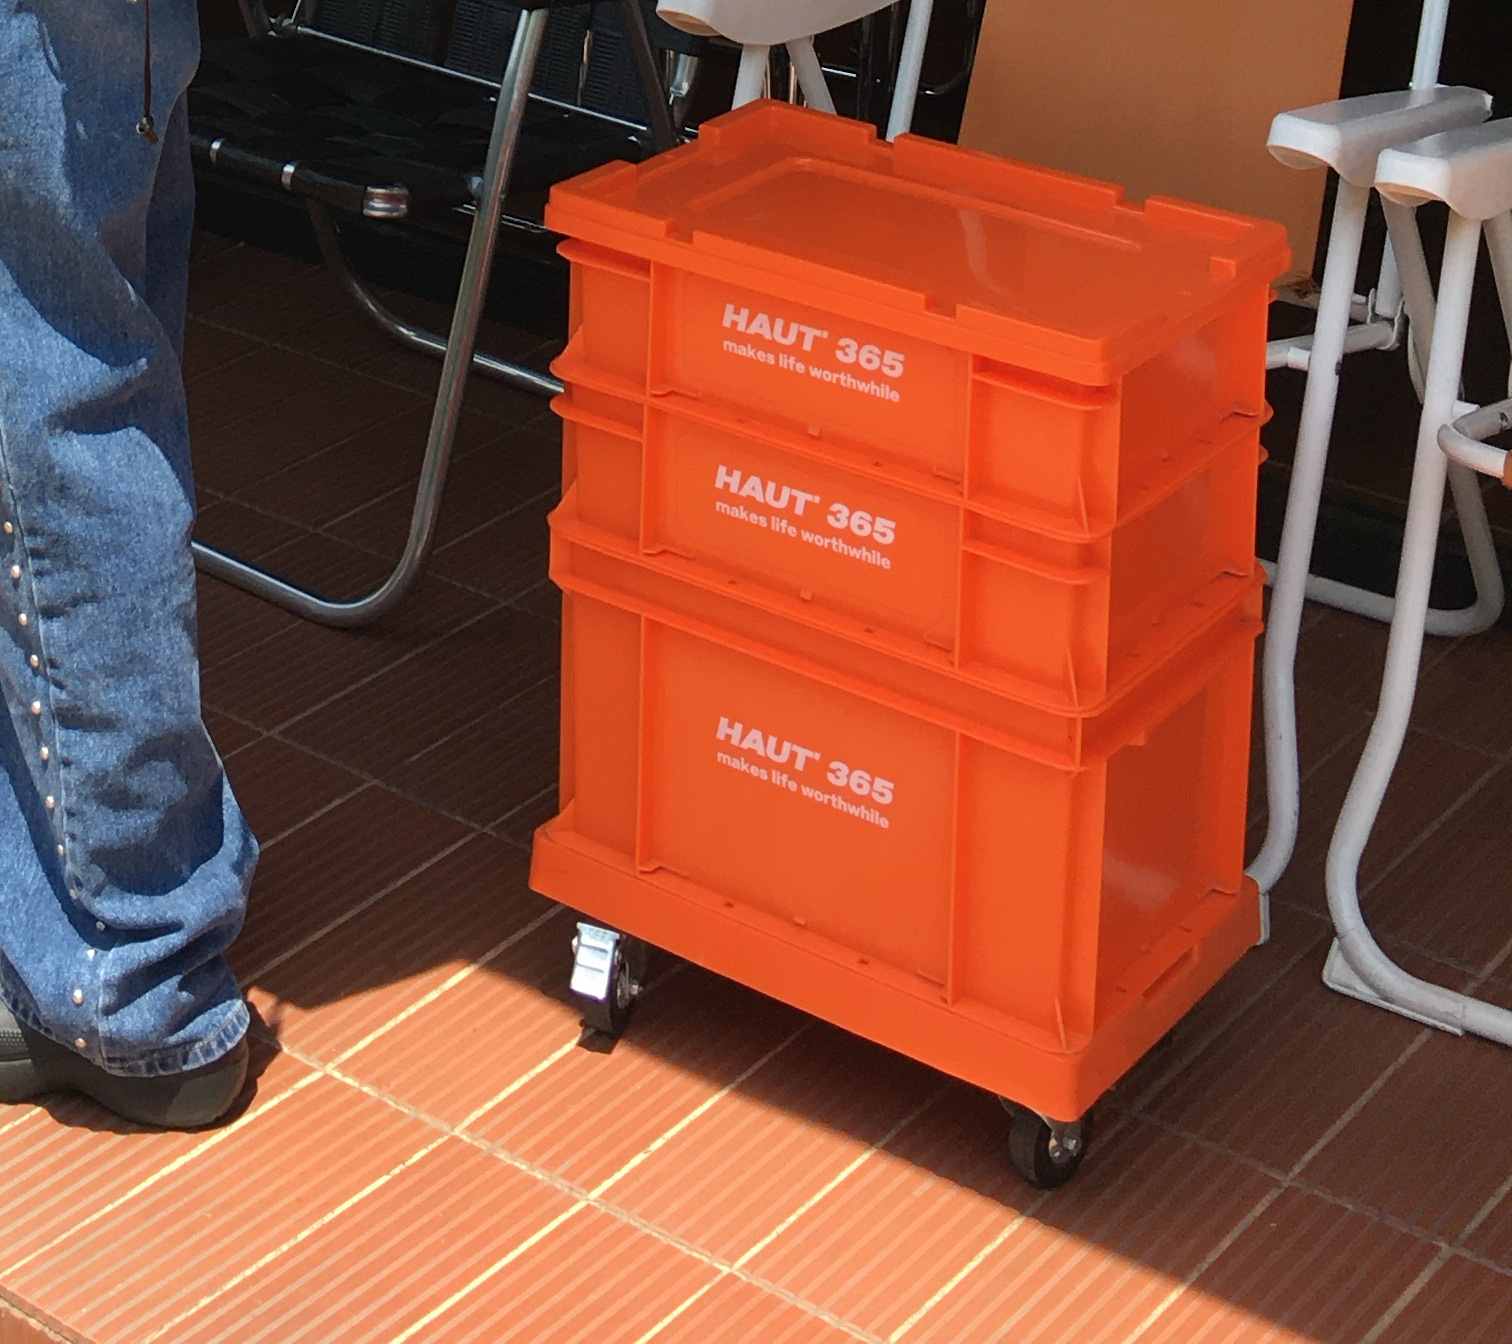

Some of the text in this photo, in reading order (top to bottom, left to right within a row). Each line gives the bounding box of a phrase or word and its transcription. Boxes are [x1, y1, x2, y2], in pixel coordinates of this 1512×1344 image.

[722, 338, 900, 403] makes life worthwhile
[835, 337, 905, 378] 365
[715, 499, 891, 570] makes life worthwhile
[826, 502, 896, 545] 365
[716, 751, 890, 829] makes life worthwhile
[826, 760, 895, 805] 365
